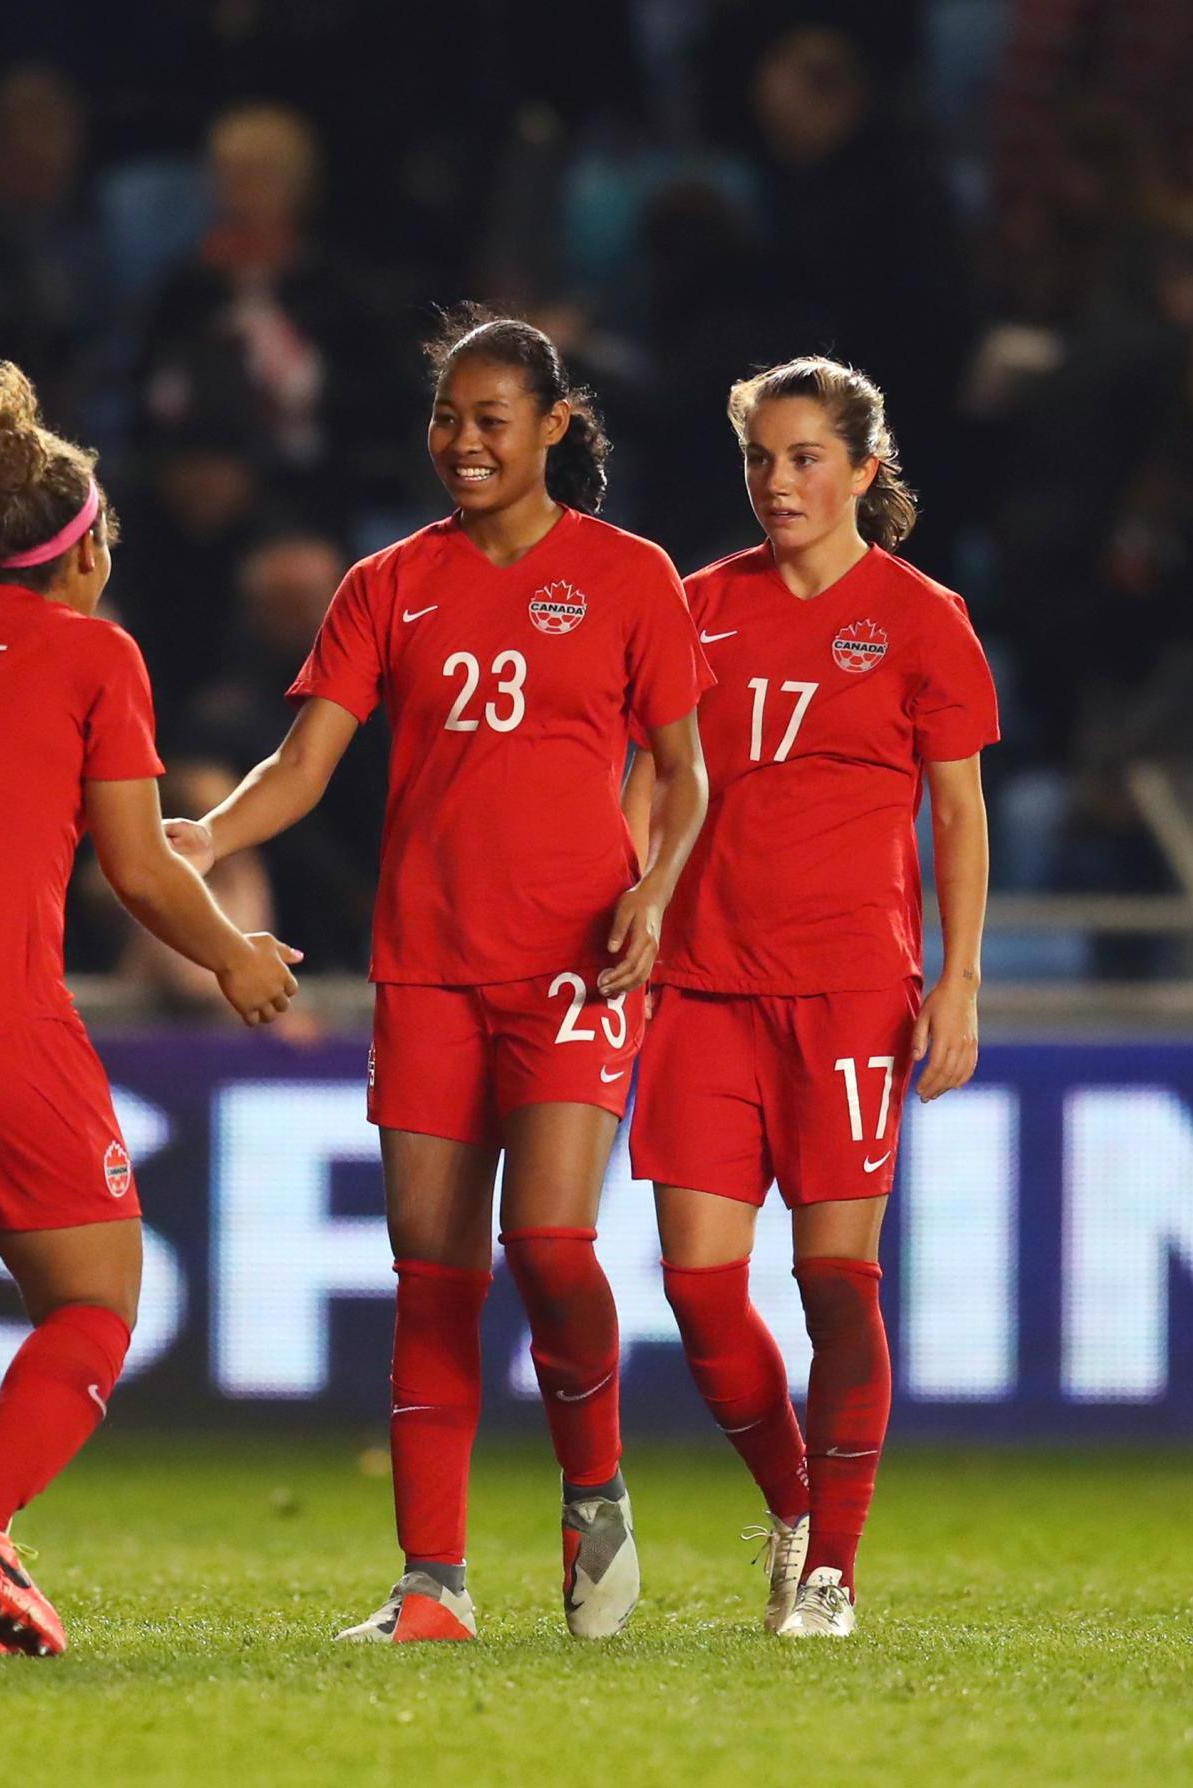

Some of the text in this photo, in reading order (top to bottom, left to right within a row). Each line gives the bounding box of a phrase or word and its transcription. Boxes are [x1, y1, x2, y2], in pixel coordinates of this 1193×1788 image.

[530, 602, 584, 616] CANADA
[834, 640, 885, 654] CANADA
[442, 649, 527, 732] 23
[747, 677, 820, 762] 17
[548, 972, 627, 1049] 23
[834, 1056, 895, 1141] 17
